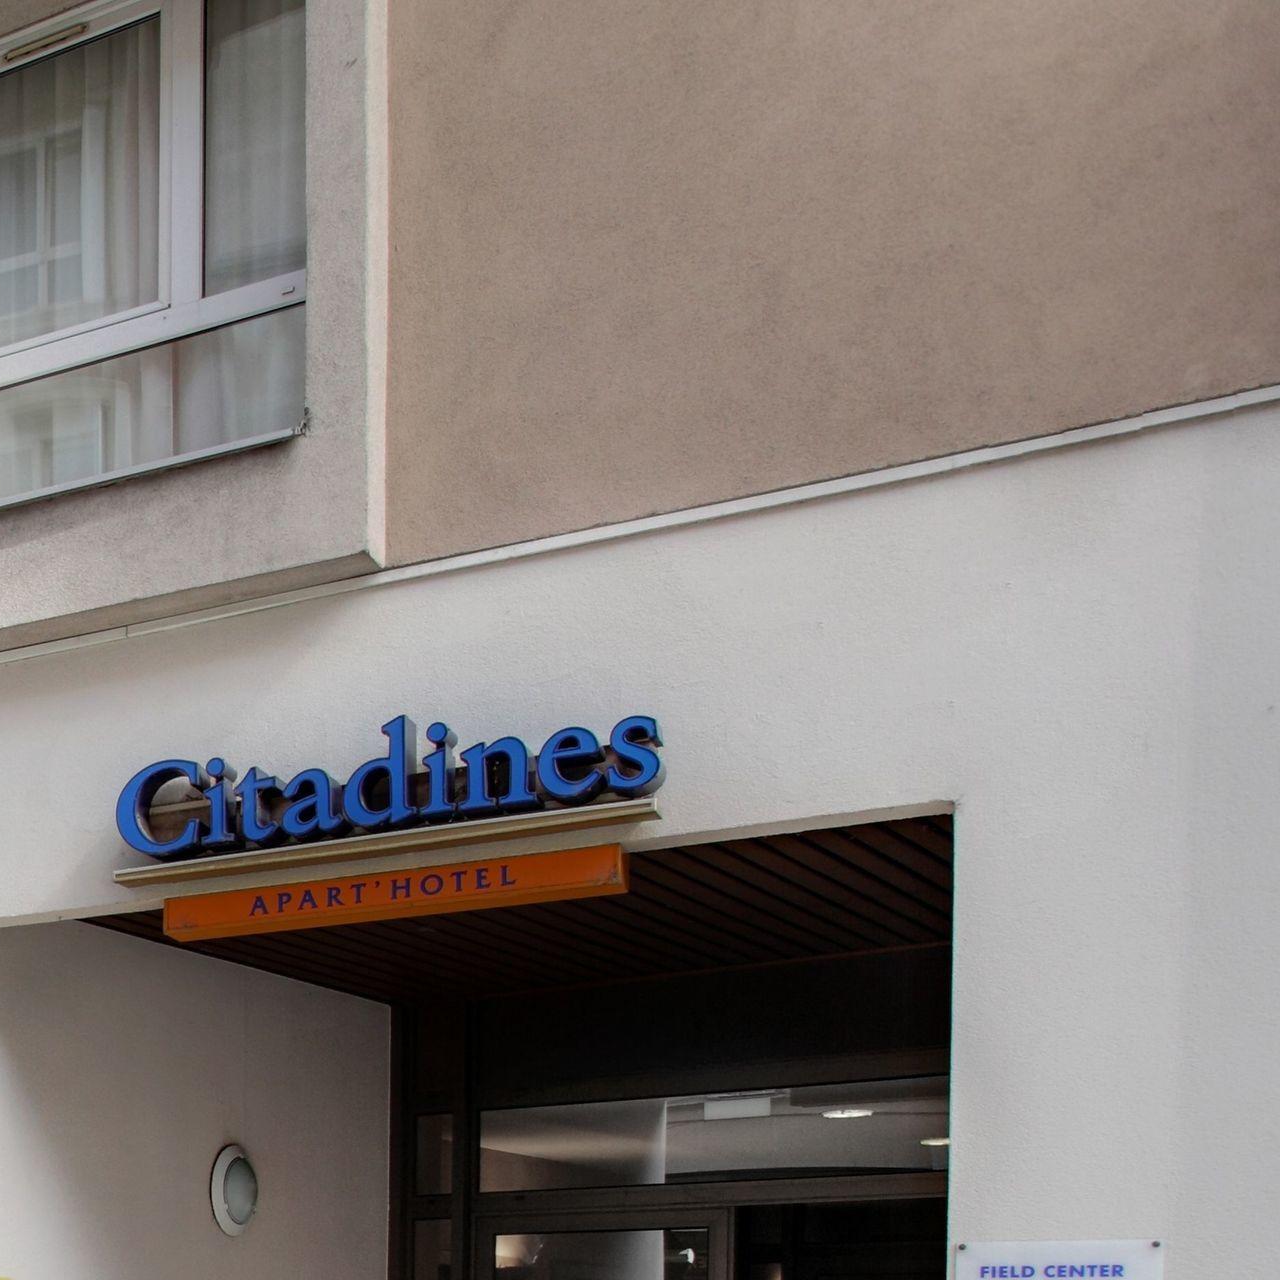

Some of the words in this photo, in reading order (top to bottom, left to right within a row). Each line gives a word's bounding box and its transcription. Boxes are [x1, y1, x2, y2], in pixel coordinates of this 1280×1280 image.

[115, 714, 665, 860] Citadines
[249, 864, 518, 918] APART'HOTEL
[980, 1266, 1035, 1278] FIELD
[1044, 1264, 1124, 1278] CENTER
